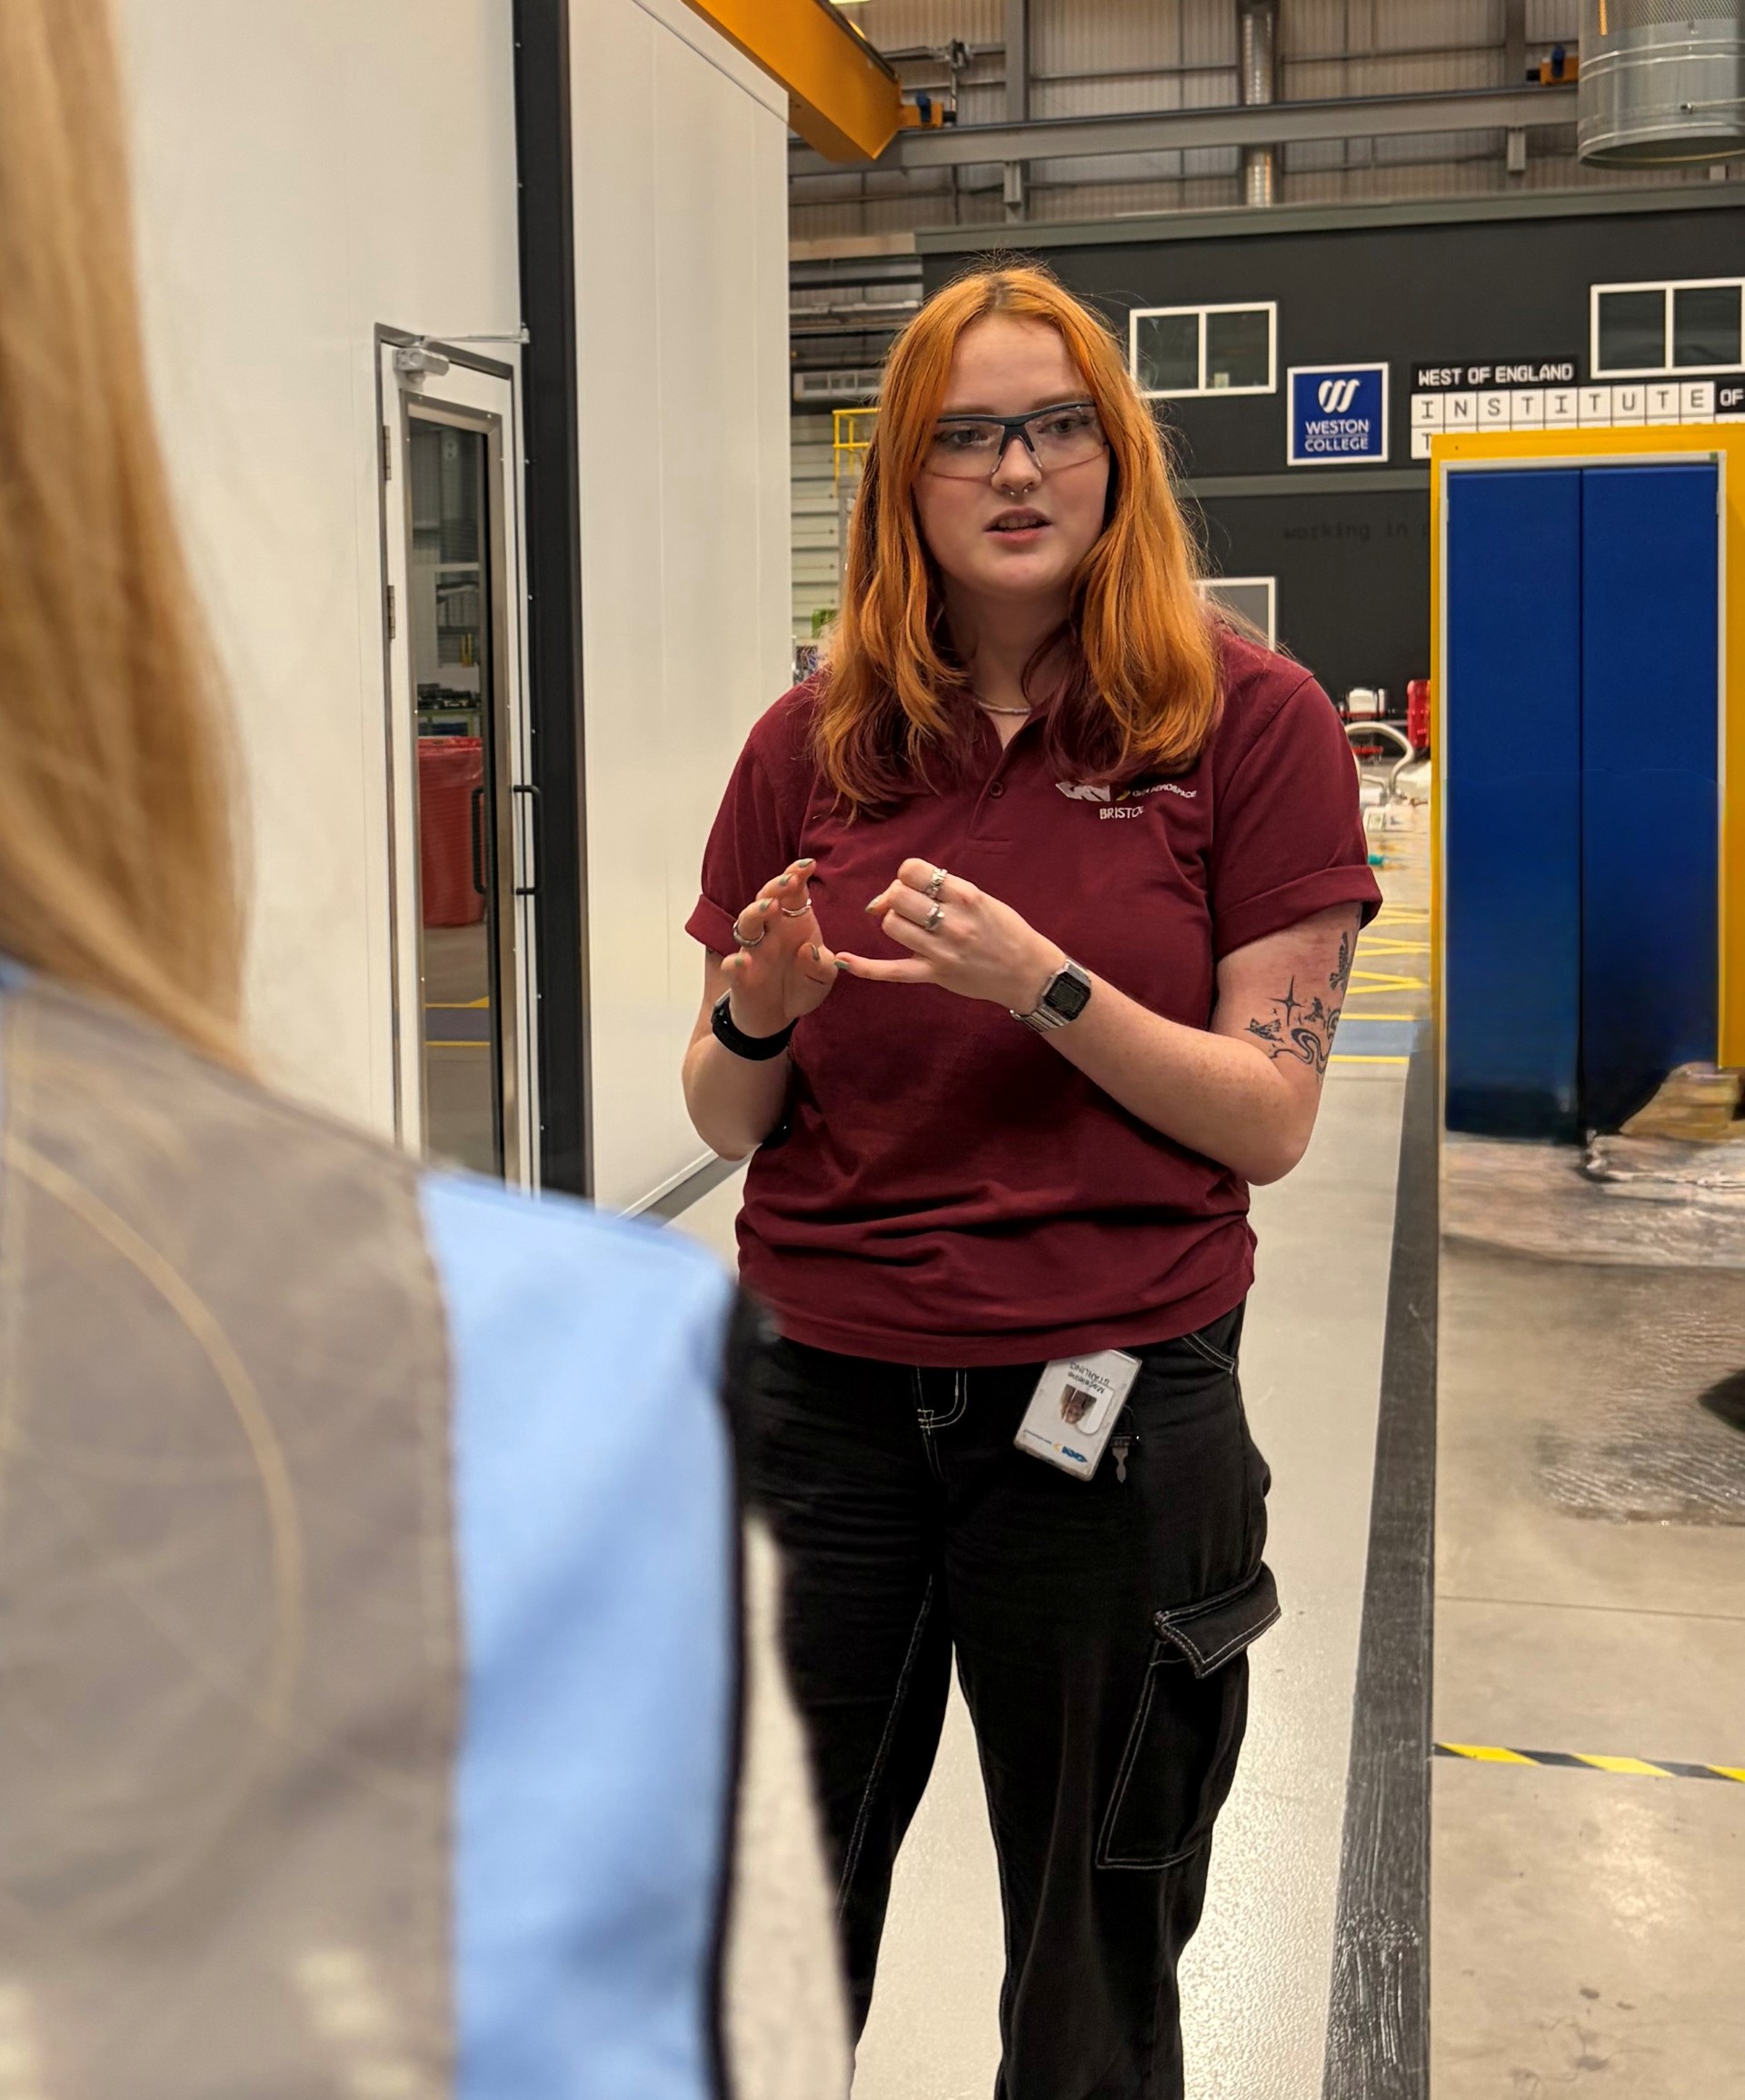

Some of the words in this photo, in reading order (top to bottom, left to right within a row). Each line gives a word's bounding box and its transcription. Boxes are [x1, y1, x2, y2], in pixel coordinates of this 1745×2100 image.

[1418, 367, 1462, 387] WEST
[1468, 366, 1491, 385] OF
[1495, 363, 1575, 383] ENGLAND
[1421, 389, 1705, 420] INSTITUTE
[1720, 388, 1744, 407] OF
[1305, 419, 1370, 434] WESTON
[1304, 437, 1369, 453] COLLEGE
[1283, 520, 1371, 542] working
